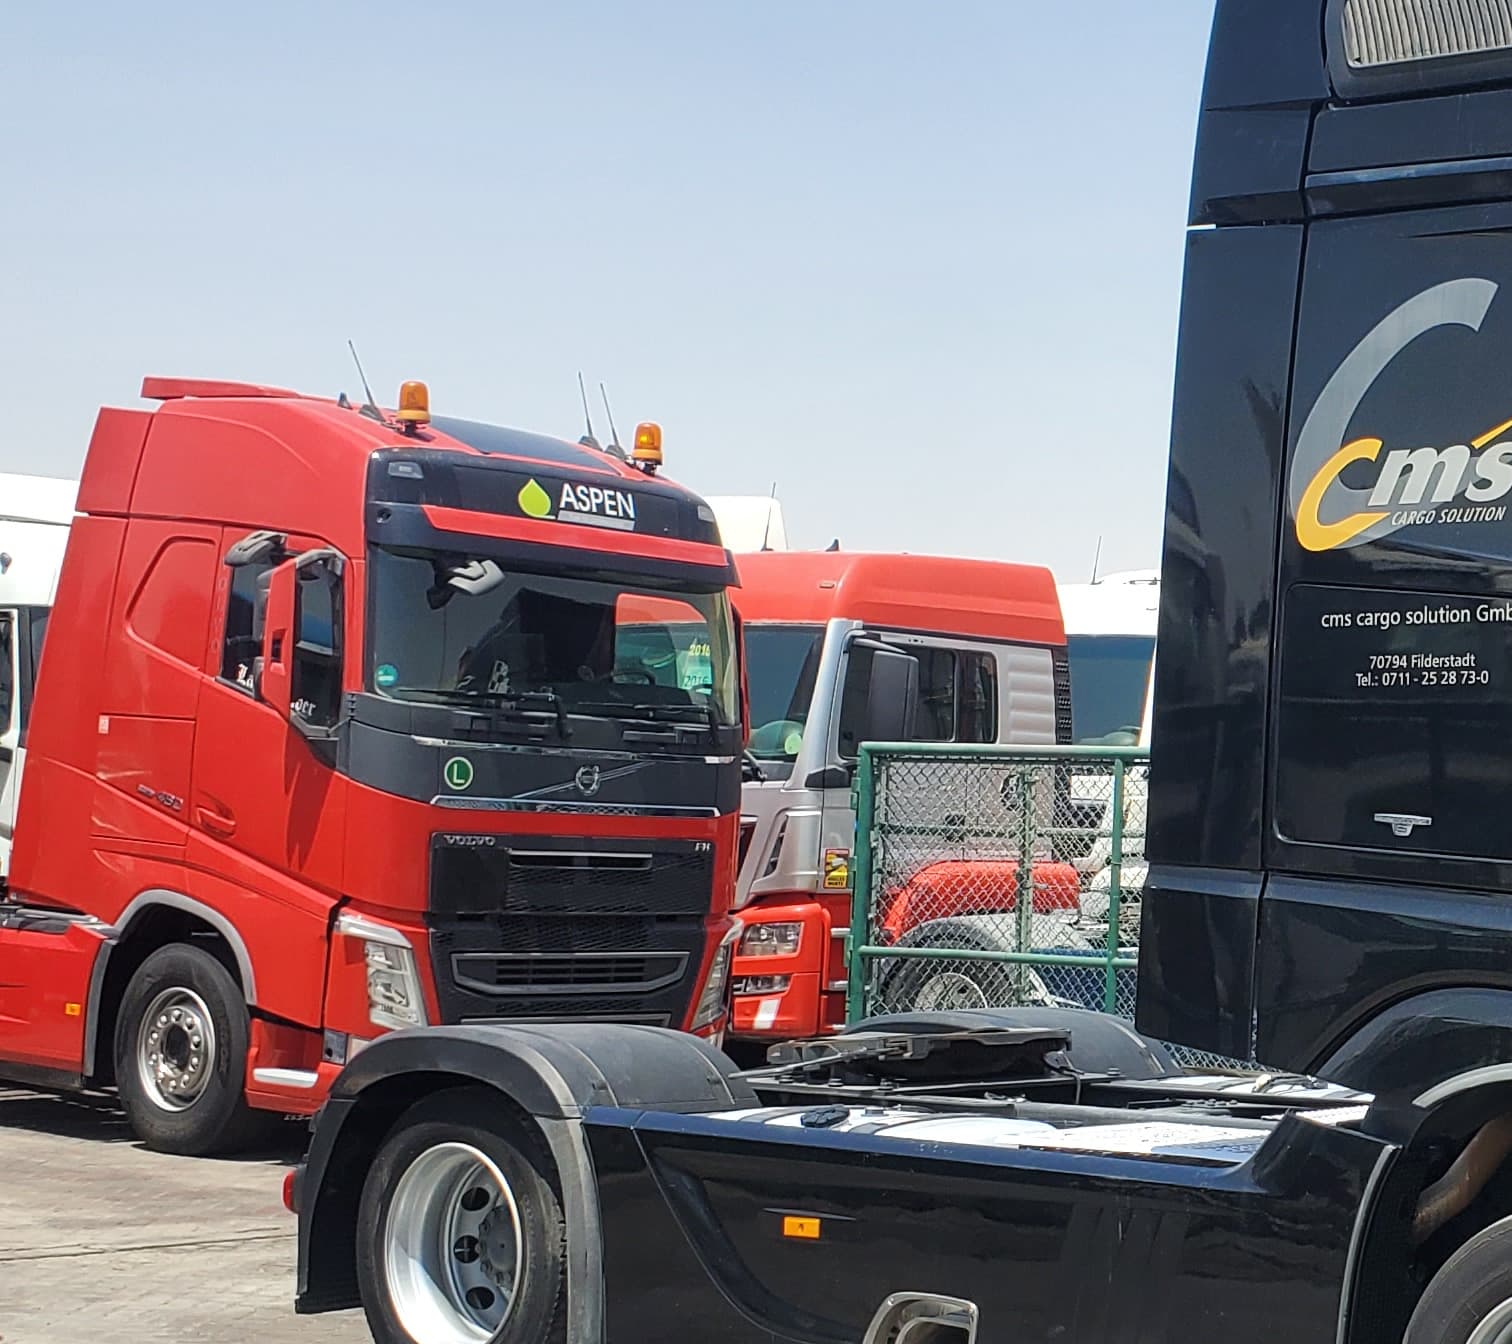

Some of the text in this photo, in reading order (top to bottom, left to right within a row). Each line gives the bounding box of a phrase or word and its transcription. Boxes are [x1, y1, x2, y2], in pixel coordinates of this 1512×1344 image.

[559, 482, 636, 519] ASPEN
[1391, 506, 1507, 526] CARGO SOLUTION
[1321, 613, 1352, 628] cms
[1356, 611, 1401, 630] cargo
[1405, 605, 1471, 625] solution
[1369, 652, 1476, 670] 70794 Filderstadt
[1355, 672, 1379, 687] Tel.:
[1382, 671, 1410, 686] 0711
[1421, 671, 1438, 686] 25
[1440, 671, 1457, 685] 28
[1460, 670, 1489, 685] 73-0
[452, 762, 465, 784] L
[443, 834, 496, 847] VOLVO
